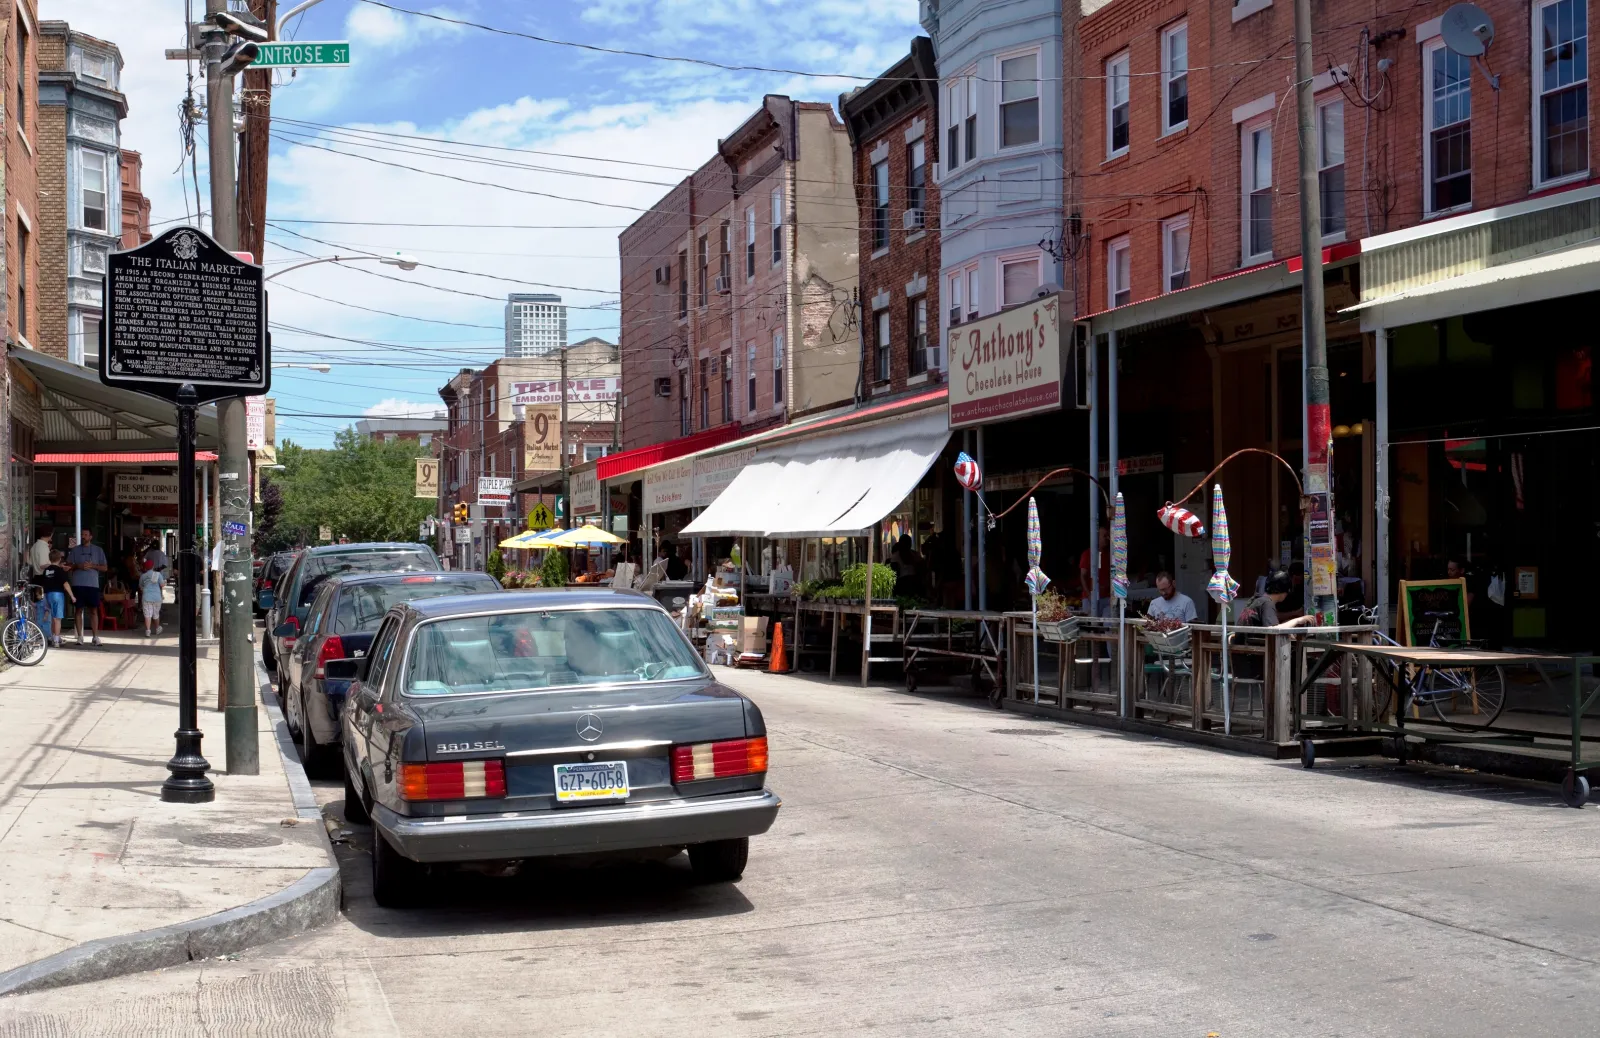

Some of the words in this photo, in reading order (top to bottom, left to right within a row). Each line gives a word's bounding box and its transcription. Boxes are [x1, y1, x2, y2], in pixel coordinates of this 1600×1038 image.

[255, 46, 323, 63] ONTROSE
[333, 50, 346, 62] ST
[155, 258, 196, 271] ITALIAN
[114, 275, 151, 284] AMERICANS
[154, 279, 191, 288] ORGANIZED
[202, 282, 230, 291] BUSINESS
[150, 271, 175, 279] SECOND
[178, 273, 219, 283] GENERATION
[163, 287, 199, 296] COMPETING
[132, 298, 159, 306] CENTRAL
[173, 301, 202, 310] SOUTHERN
[202, 297, 235, 306] ANCESTRIES
[142, 313, 174, 322] NORTHERN
[193, 317, 221, 325] EASTERN
[160, 307, 188, 316] MEMBERS
[225, 312, 256, 321] AMERICANS
[114, 318, 144, 327] LEBANESE
[129, 327, 159, 335] PRODUCTS
[137, 334, 175, 343] FOUNDATION
[159, 343, 207, 352] MANUFACTURERS
[962, 322, 1045, 370] Anthony's
[966, 366, 1012, 396] Chocolate
[1016, 360, 1042, 386] House
[514, 379, 606, 394] TRIPLE
[516, 393, 579, 402] EMBROIDRY
[952, 390, 1058, 419] www.anthonyschocolatehouse.com
[535, 412, 548, 444] 9
[423, 464, 431, 483] 9
[118, 484, 130, 492] THE
[133, 484, 150, 492] SPICE
[152, 485, 178, 493] CORNER
[480, 479, 498, 490] TRIPLE
[225, 520, 245, 532] PAUL
[473, 740, 505, 750] SEL
